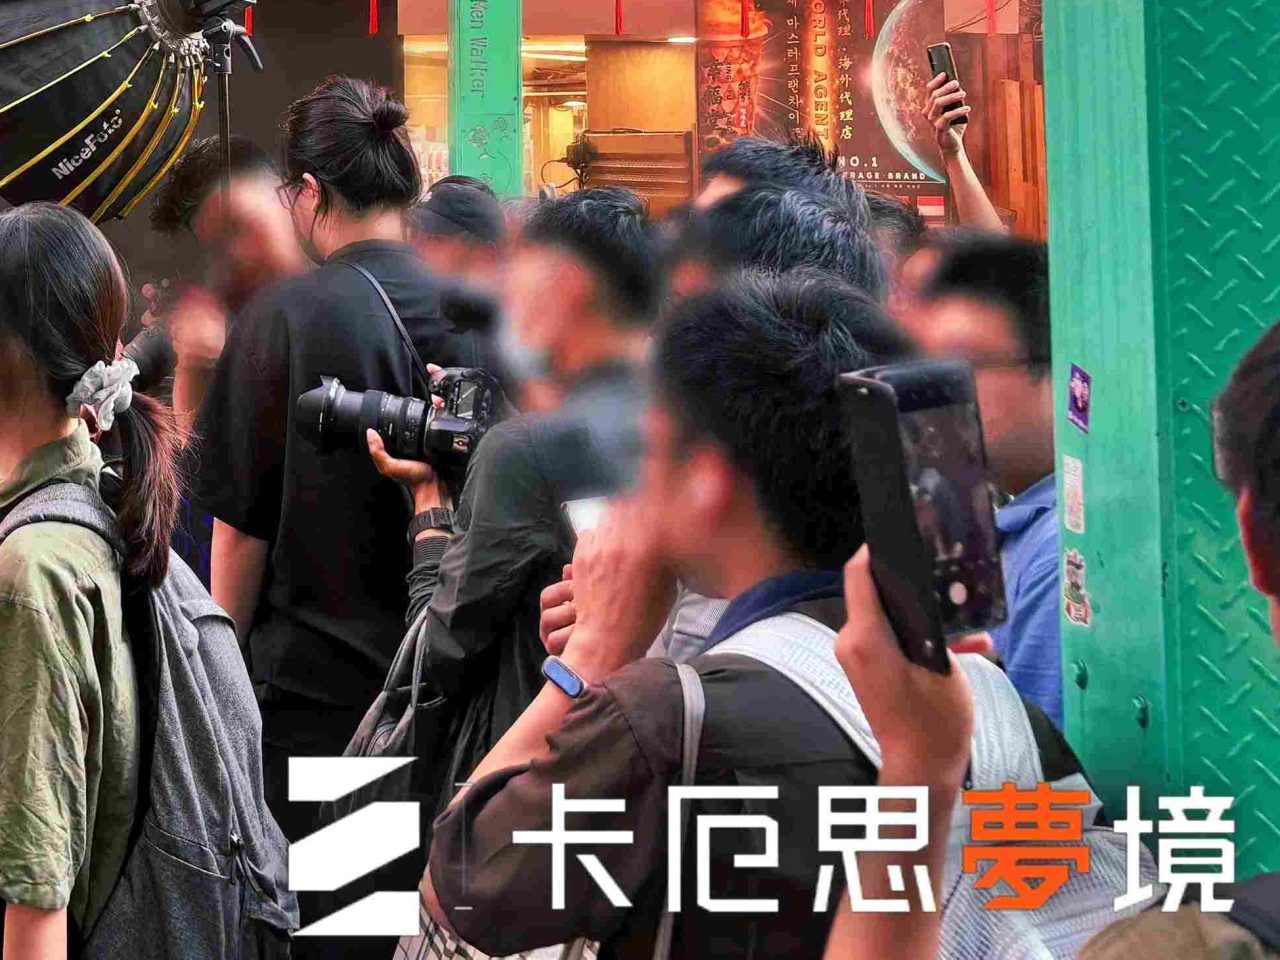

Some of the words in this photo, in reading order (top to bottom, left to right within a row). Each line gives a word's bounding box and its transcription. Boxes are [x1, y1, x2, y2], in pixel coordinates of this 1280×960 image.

[469, 36, 488, 99] Walker
[838, 55, 854, 140] 海外代理店
[814, 70, 829, 140] AGENT
[51, 113, 123, 180] NiceFoto
[888, 172, 927, 180] BRAND
